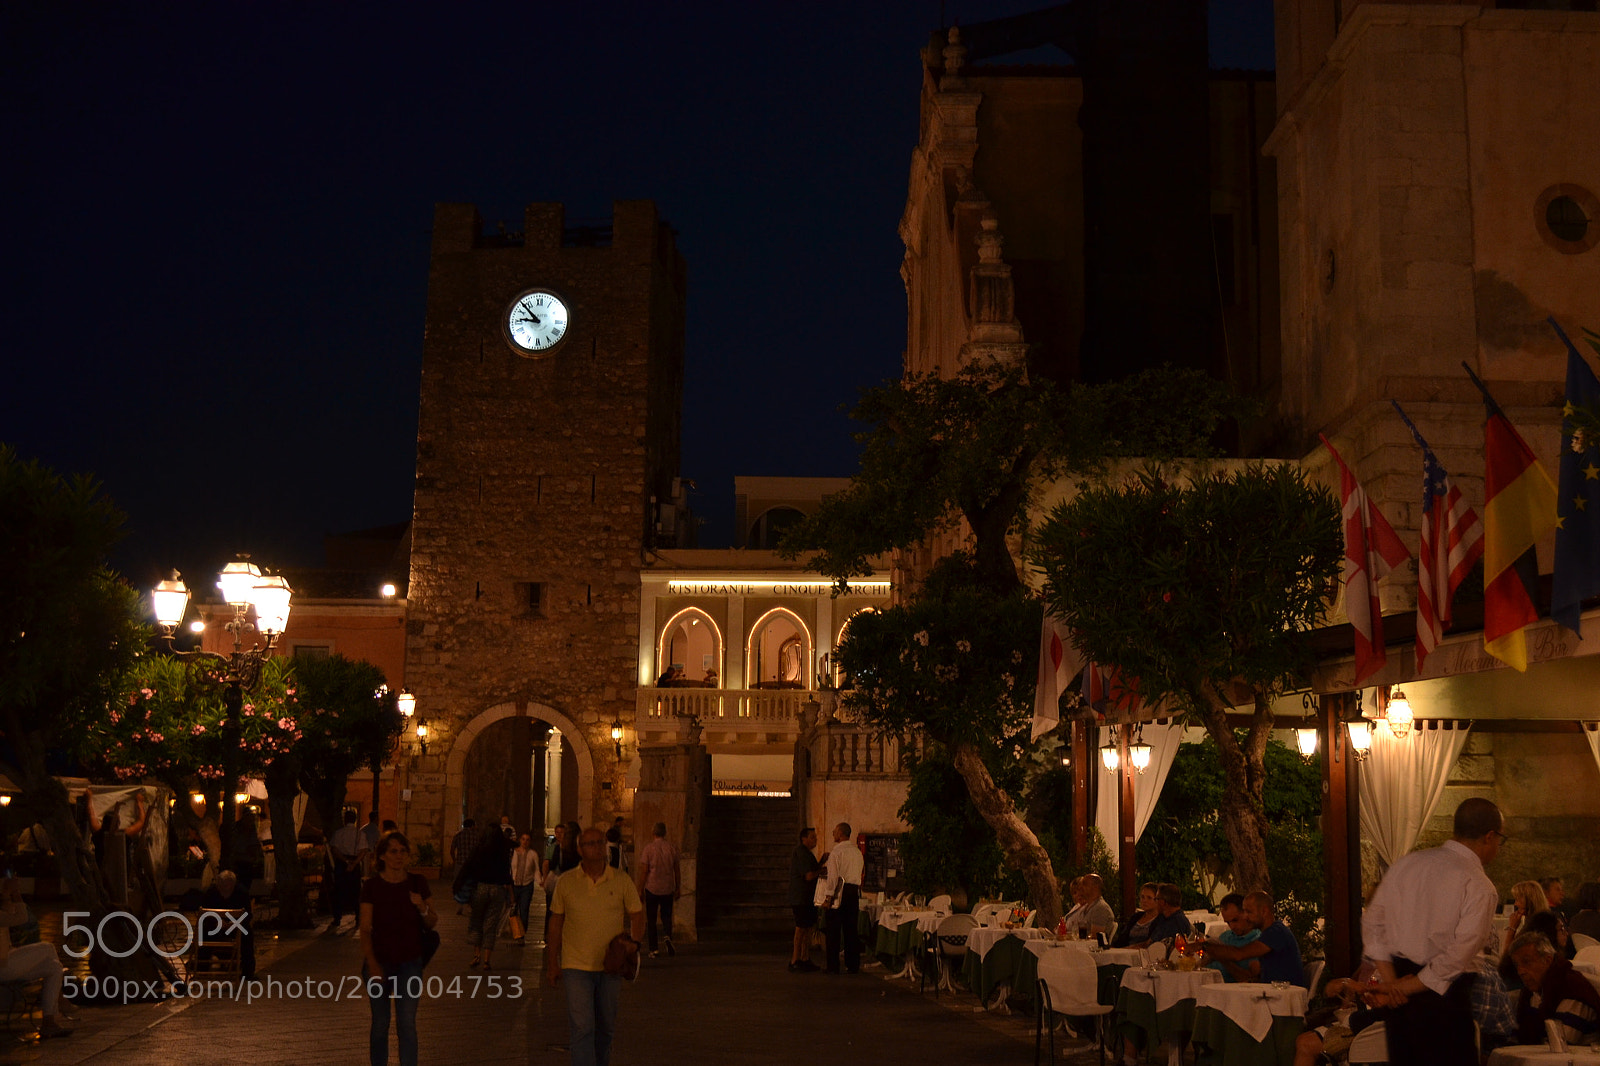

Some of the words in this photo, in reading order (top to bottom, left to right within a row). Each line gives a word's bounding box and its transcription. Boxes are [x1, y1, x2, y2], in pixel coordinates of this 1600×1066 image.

[668, 583, 755, 594] RISTORANTE
[773, 584, 826, 595] CINQUE
[1443, 642, 1502, 674] Mocam
[1534, 628, 1569, 660] Bar
[713, 780, 767, 791] Wunderbar
